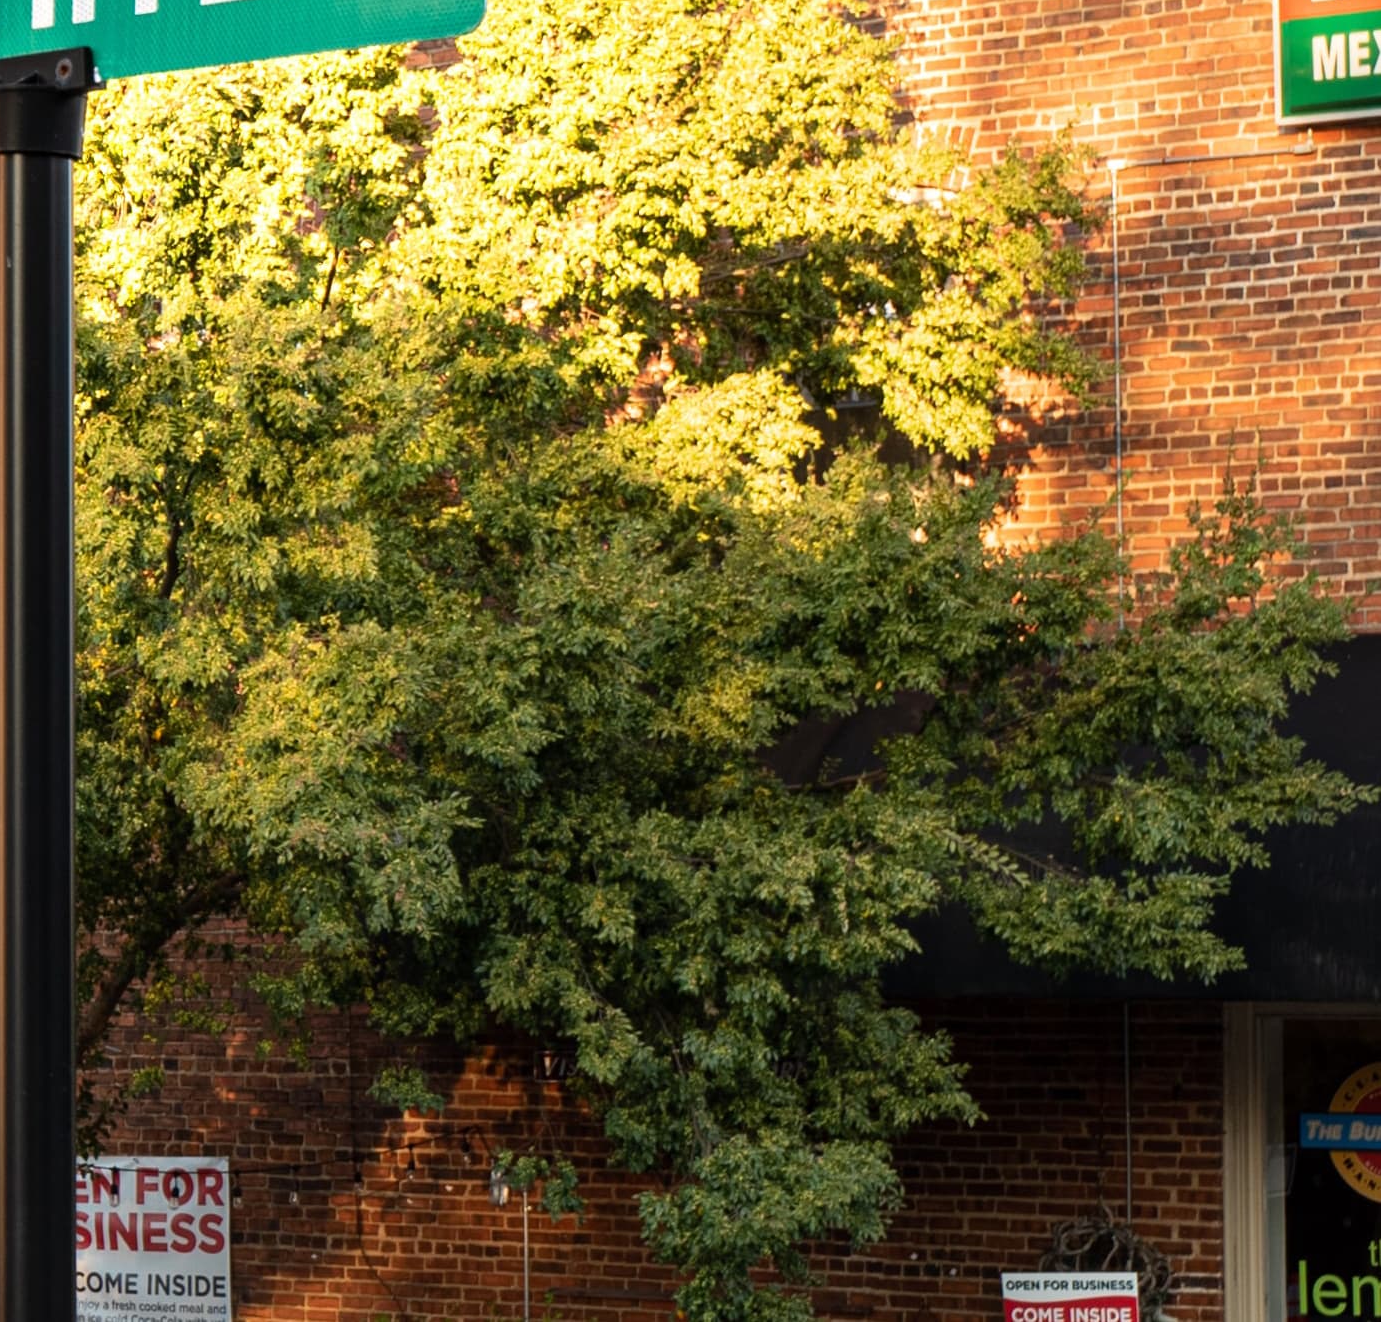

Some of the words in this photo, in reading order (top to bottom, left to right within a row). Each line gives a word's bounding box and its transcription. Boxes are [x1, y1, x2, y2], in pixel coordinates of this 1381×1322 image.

[136, 1166, 225, 1207] FOR
[75, 1210, 226, 1255] SINESS
[76, 1271, 139, 1295] COME
[146, 1273, 227, 1298] INSIDE
[1005, 1279, 1041, 1291] OPEN
[1043, 1279, 1069, 1291] FOR
[1071, 1279, 1135, 1291] BUSINESS
[77, 1299, 100, 1313] njoy
[102, 1301, 110, 1311] a
[111, 1300, 137, 1312] fresh
[138, 1301, 176, 1313] cooked
[178, 1303, 204, 1314] meal
[206, 1304, 227, 1315] and
[1010, 1306, 1065, 1322] COME
[1069, 1306, 1133, 1322] INSIDE
